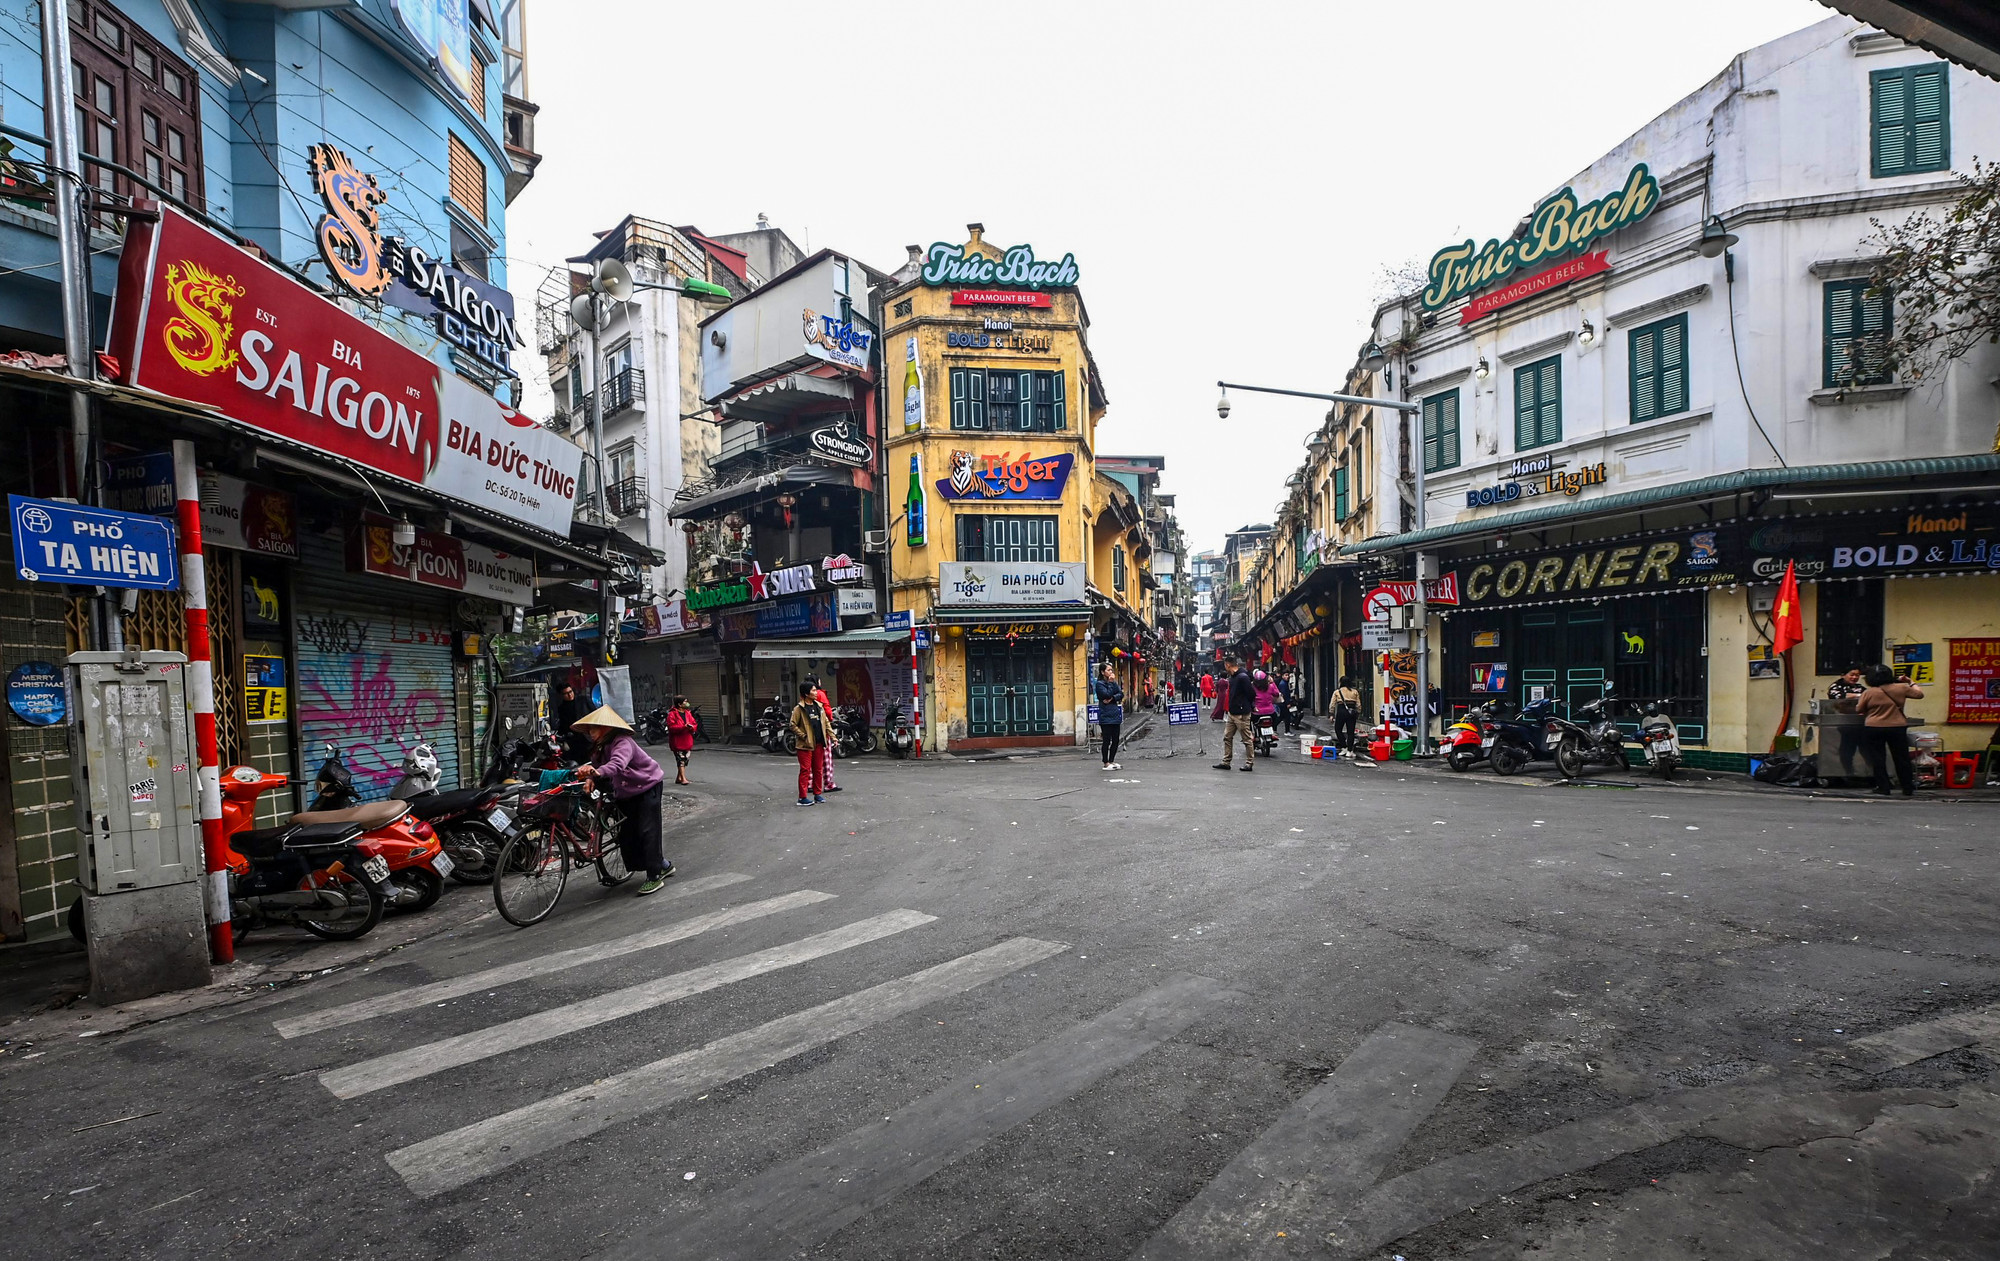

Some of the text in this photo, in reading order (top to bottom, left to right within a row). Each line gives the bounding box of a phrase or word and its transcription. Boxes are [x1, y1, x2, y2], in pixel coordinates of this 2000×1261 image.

[1425, 170, 1653, 306] Trúc Bạch
[393, 235, 404, 276] BIA
[924, 243, 1078, 288] Trúc Bạch
[1477, 260, 1585, 311] PARAMOUNT BEER
[410, 246, 518, 351] SAIGON
[963, 293, 1037, 303] PARAMOUNT BEER
[256, 307, 278, 328] EST.
[984, 317, 1013, 331] Hanoi
[821, 315, 870, 353] Tiger
[947, 332, 1050, 354] BOLD & Light
[331, 339, 362, 371] BIA
[443, 313, 518, 378] CHILL
[236, 329, 423, 455] SAIGON
[405, 385, 421, 400] 1875
[817, 434, 867, 457] STRONGBOW
[827, 448, 861, 463] APPLE CIDERS
[446, 418, 575, 500] BIA ĐỨC TÙNG
[1511, 454, 1551, 476] Hanoi
[117, 461, 146, 480] PHỐ
[981, 451, 1059, 492] Tiger
[485, 479, 541, 512] ĐC: Số 20 Tạ Hiện
[1466, 462, 1607, 508] BOLD & Light
[72, 520, 123, 540] PHỐ
[1907, 511, 1967, 534] Hanoi
[257, 537, 295, 555] SAIGON
[270, 532, 282, 541] BIA
[420, 537, 433, 548] BIA
[39, 540, 160, 579] TẠ HIỆN
[1686, 557, 1718, 565] SAIGON
[1833, 544, 1919, 568] BOLD
[1925, 546, 1945, 563] &
[467, 558, 532, 588] BIA ĐỨC TÙNG
[770, 564, 816, 596] SILVER
[831, 568, 846, 581] BIA
[1002, 570, 1065, 586] BIA PHỐ CỔ
[1466, 541, 1680, 601] CORNER
[1678, 577, 1693, 585] 27
[685, 582, 749, 611] Heineken
[953, 581, 986, 597] Tiger
[785, 602, 801, 617] VIEW
[860, 602, 873, 610] VIEW
[550, 643, 572, 651] MASSAGE
[1952, 640, 1981, 656] BÚN
[1494, 663, 1508, 671] VENUS
[1960, 656, 1988, 667] PHỐ
[129, 778, 156, 795] PARIS
